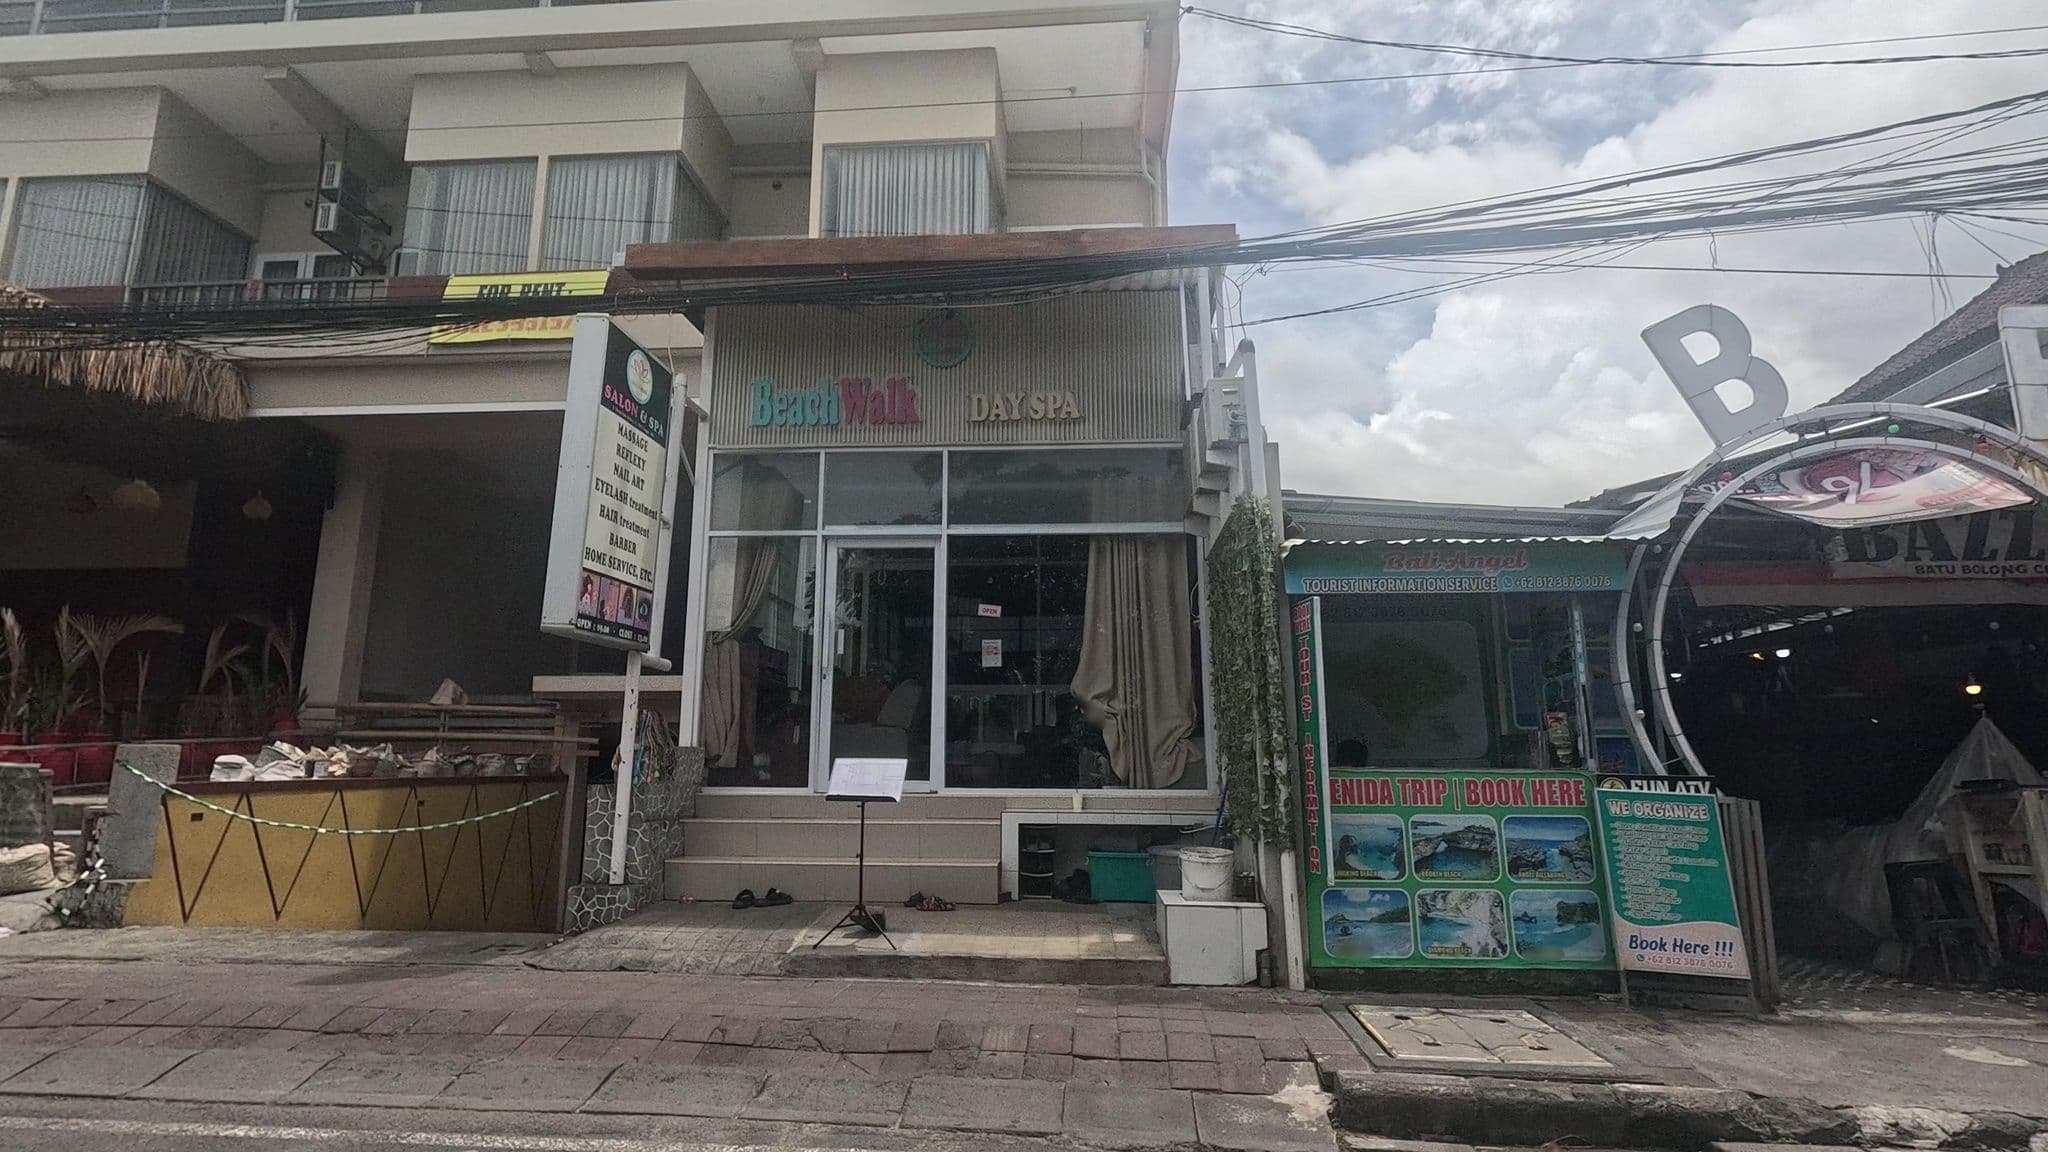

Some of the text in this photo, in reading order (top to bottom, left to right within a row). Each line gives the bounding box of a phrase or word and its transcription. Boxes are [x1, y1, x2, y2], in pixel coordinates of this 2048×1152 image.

[520, 282, 566, 297] RENT
[1641, 303, 1788, 447] B
[604, 384, 638, 417] SALON
[648, 417, 665, 438] SPA
[970, 391, 1081, 422] DAY SPA
[617, 422, 648, 453] MASSAGE
[613, 463, 644, 491] NAIL ART
[594, 477, 658, 520] EYELASH treatment
[599, 504, 650, 539] HAIR treatment
[609, 532, 637, 555] BARBER
[584, 546, 607, 566] HOME
[1915, 565, 1955, 575] BATU
[1961, 564, 2027, 576] BOLONG
[1303, 576, 1498, 592] TOURIST INFORMATION SERVICE
[1536, 576, 1554, 588] 812
[1556, 576, 1581, 588] 3876
[1584, 576, 1611, 587] 0076
[982, 607, 998, 615] OPEN
[576, 618, 592, 628] OPEN
[618, 628, 633, 640] CLOSE
[1299, 635, 1312, 721] TOURIST
[1397, 779, 1448, 806] TRIP
[1464, 779, 1526, 806] BOOK
[1530, 779, 1587, 807] HERE
[1631, 780, 1710, 794] FUN ATV
[1304, 731, 1321, 874] INFORMATION
[1608, 801, 1708, 819] WE ORGANIZE
[1629, 935, 1733, 957] Book Here !!!
[1666, 957, 1680, 965] 812
[1709, 961, 1733, 969] 0076
